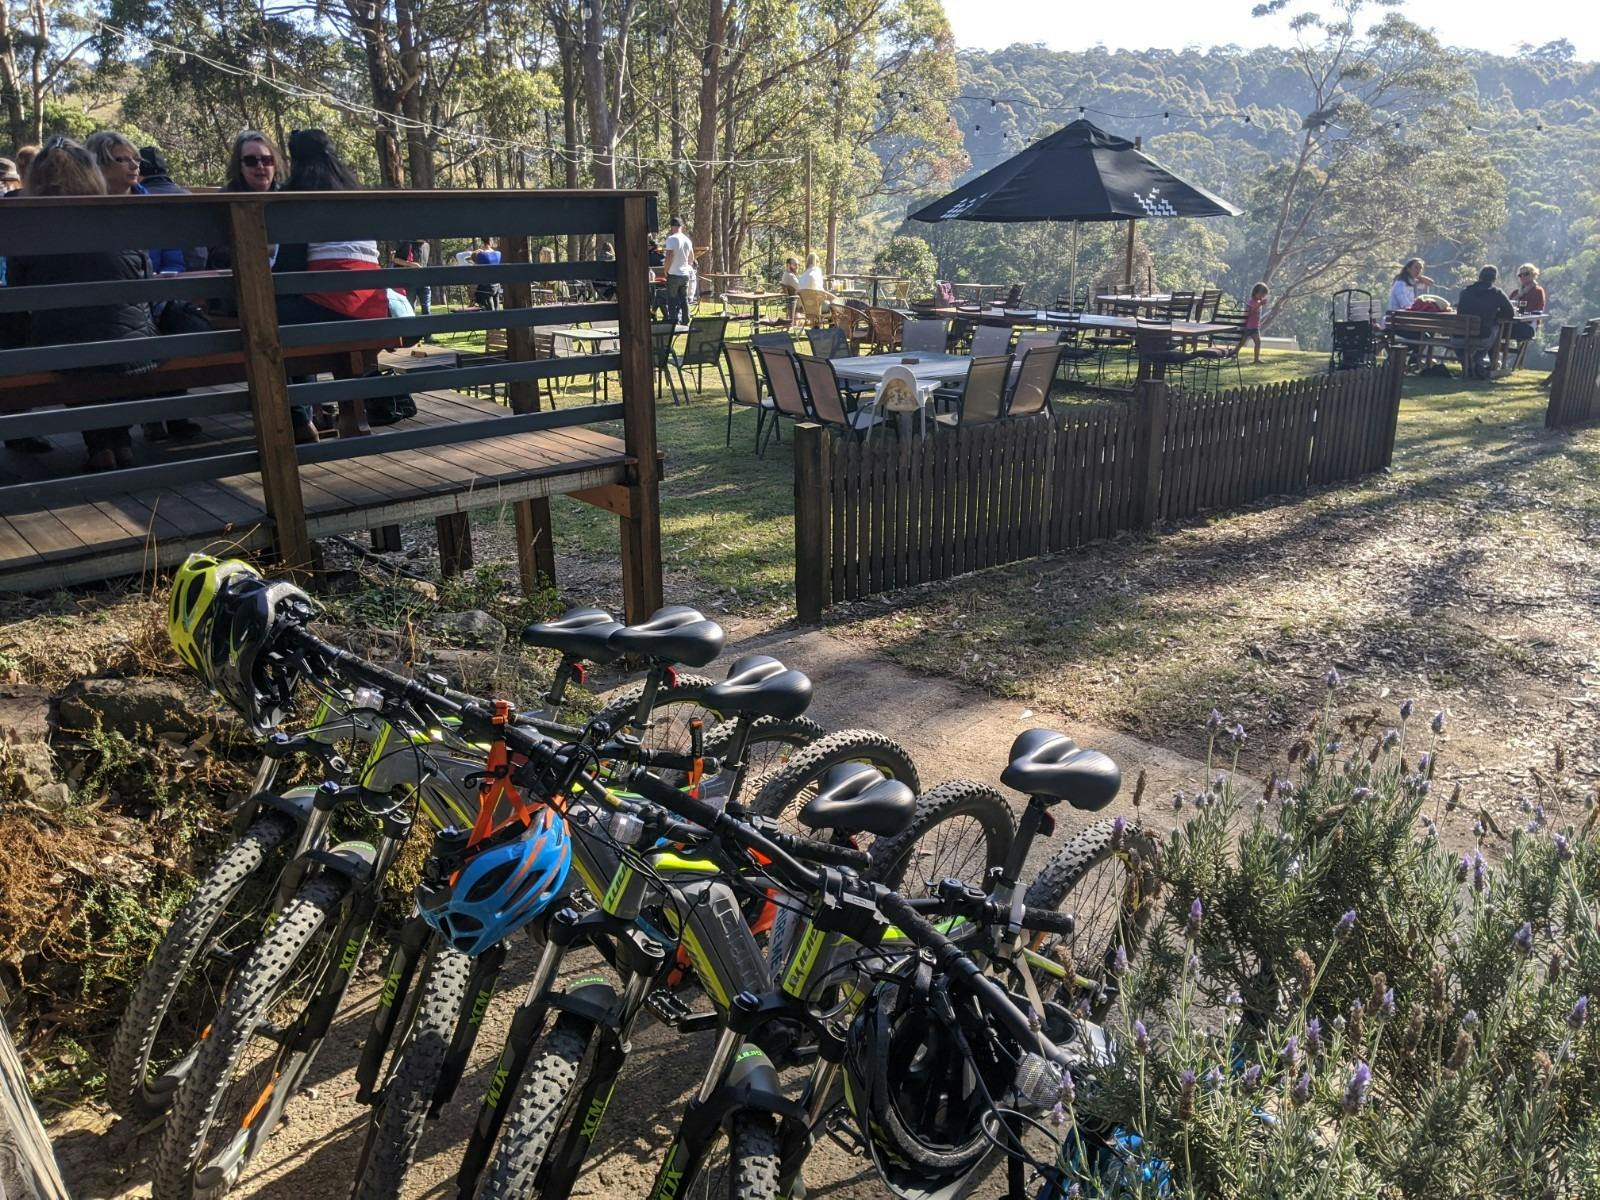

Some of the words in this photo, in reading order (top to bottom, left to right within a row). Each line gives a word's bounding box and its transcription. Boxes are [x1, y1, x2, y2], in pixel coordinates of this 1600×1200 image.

[339, 938, 360, 976] XCM
[770, 940, 783, 971] ME
[382, 968, 401, 1008] XCM
[468, 990, 490, 1025] XCM
[487, 1062, 509, 1108] XCM
[580, 1098, 604, 1139] XCM
[660, 1162, 684, 1200] XC
